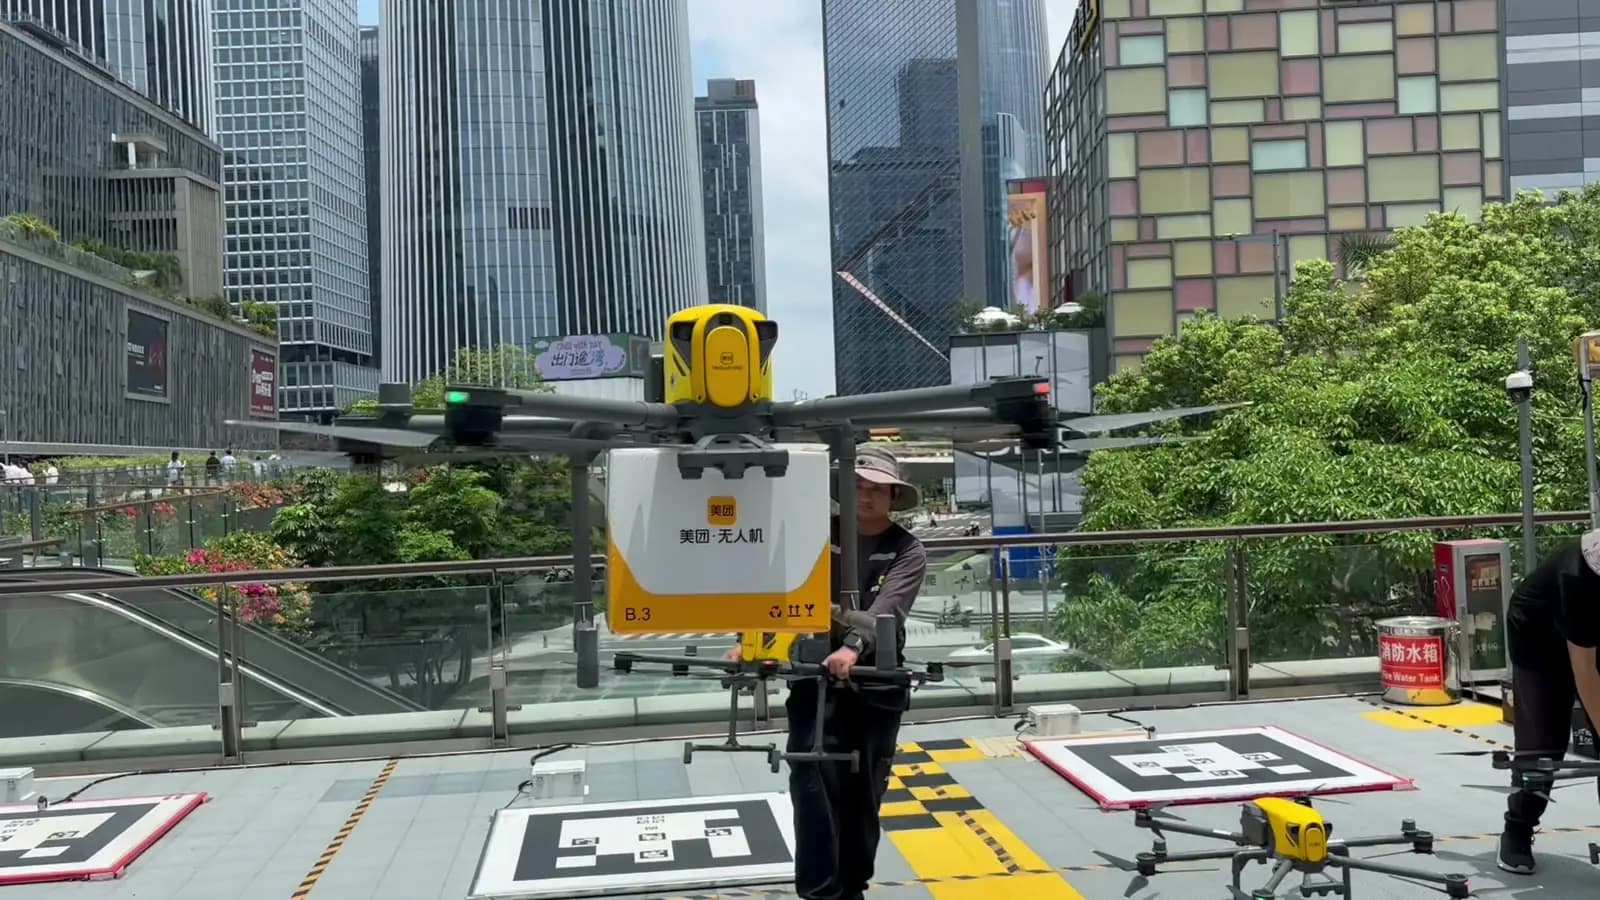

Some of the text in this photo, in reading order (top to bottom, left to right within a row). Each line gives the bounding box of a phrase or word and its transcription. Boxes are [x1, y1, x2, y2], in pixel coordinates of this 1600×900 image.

[711, 504, 734, 517] 美团
[680, 528, 764, 544] 美团·无人机
[625, 607, 651, 621] B.3
[1381, 640, 1438, 664] 消防水箱
[1392, 671, 1417, 682] Water
[1419, 673, 1440, 683] Tank
